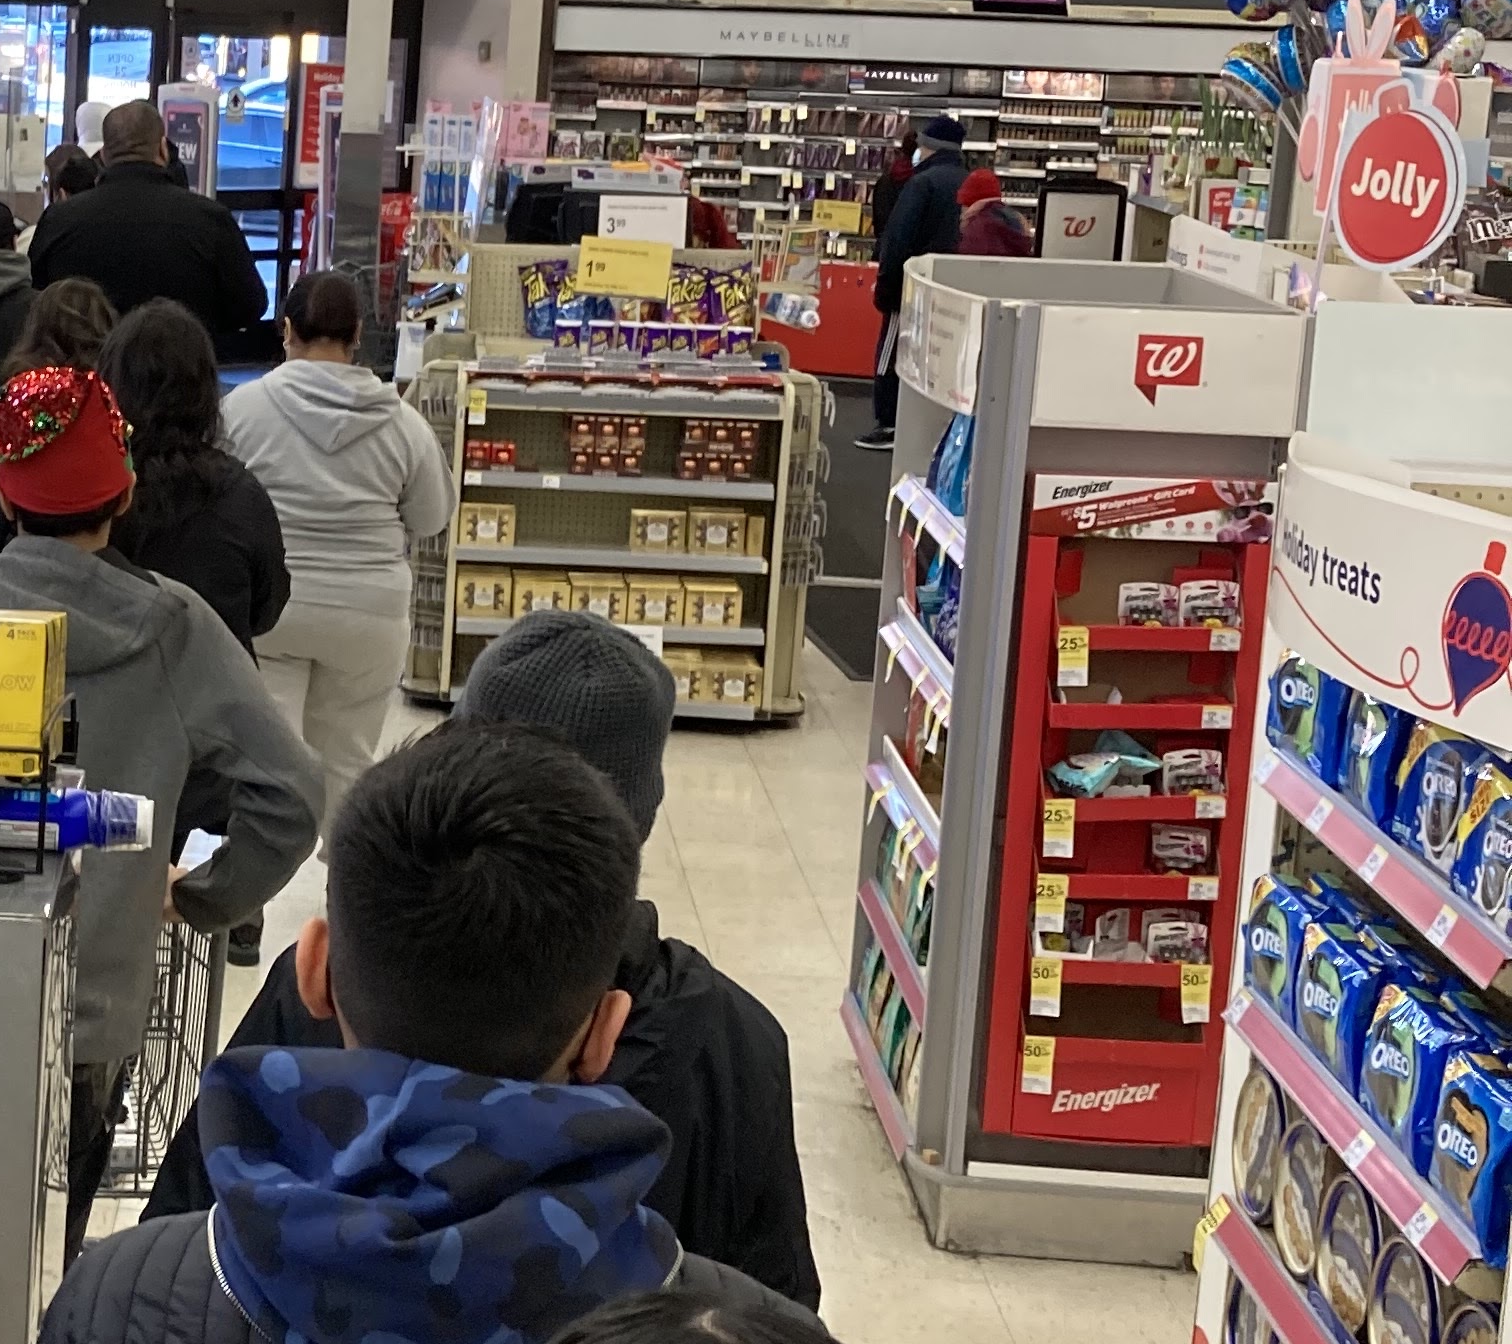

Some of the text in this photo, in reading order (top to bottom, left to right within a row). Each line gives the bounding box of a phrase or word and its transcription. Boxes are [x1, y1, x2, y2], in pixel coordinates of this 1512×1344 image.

[720, 30, 850, 43] MAYBELLINE
[176, 142, 198, 157] EW
[1350, 157, 1440, 218] Jolly
[1143, 341, 1197, 378] W
[1052, 480, 1114, 500] Energizer
[1172, 486, 1196, 498] Card
[1321, 545, 1382, 605] treats
[6, 628, 15, 640] 4
[1280, 676, 1315, 706] OREO
[1044, 809, 1063, 822] 25
[1037, 884, 1055, 897] 25
[1032, 967, 1049, 980] 50
[1182, 973, 1199, 986] 50
[1303, 979, 1338, 1018] OREO
[1024, 1045, 1041, 1058] 50
[1370, 1042, 1409, 1078] OREO
[1051, 1082, 1161, 1114] Energizer
[1437, 1123, 1478, 1168] OREO
